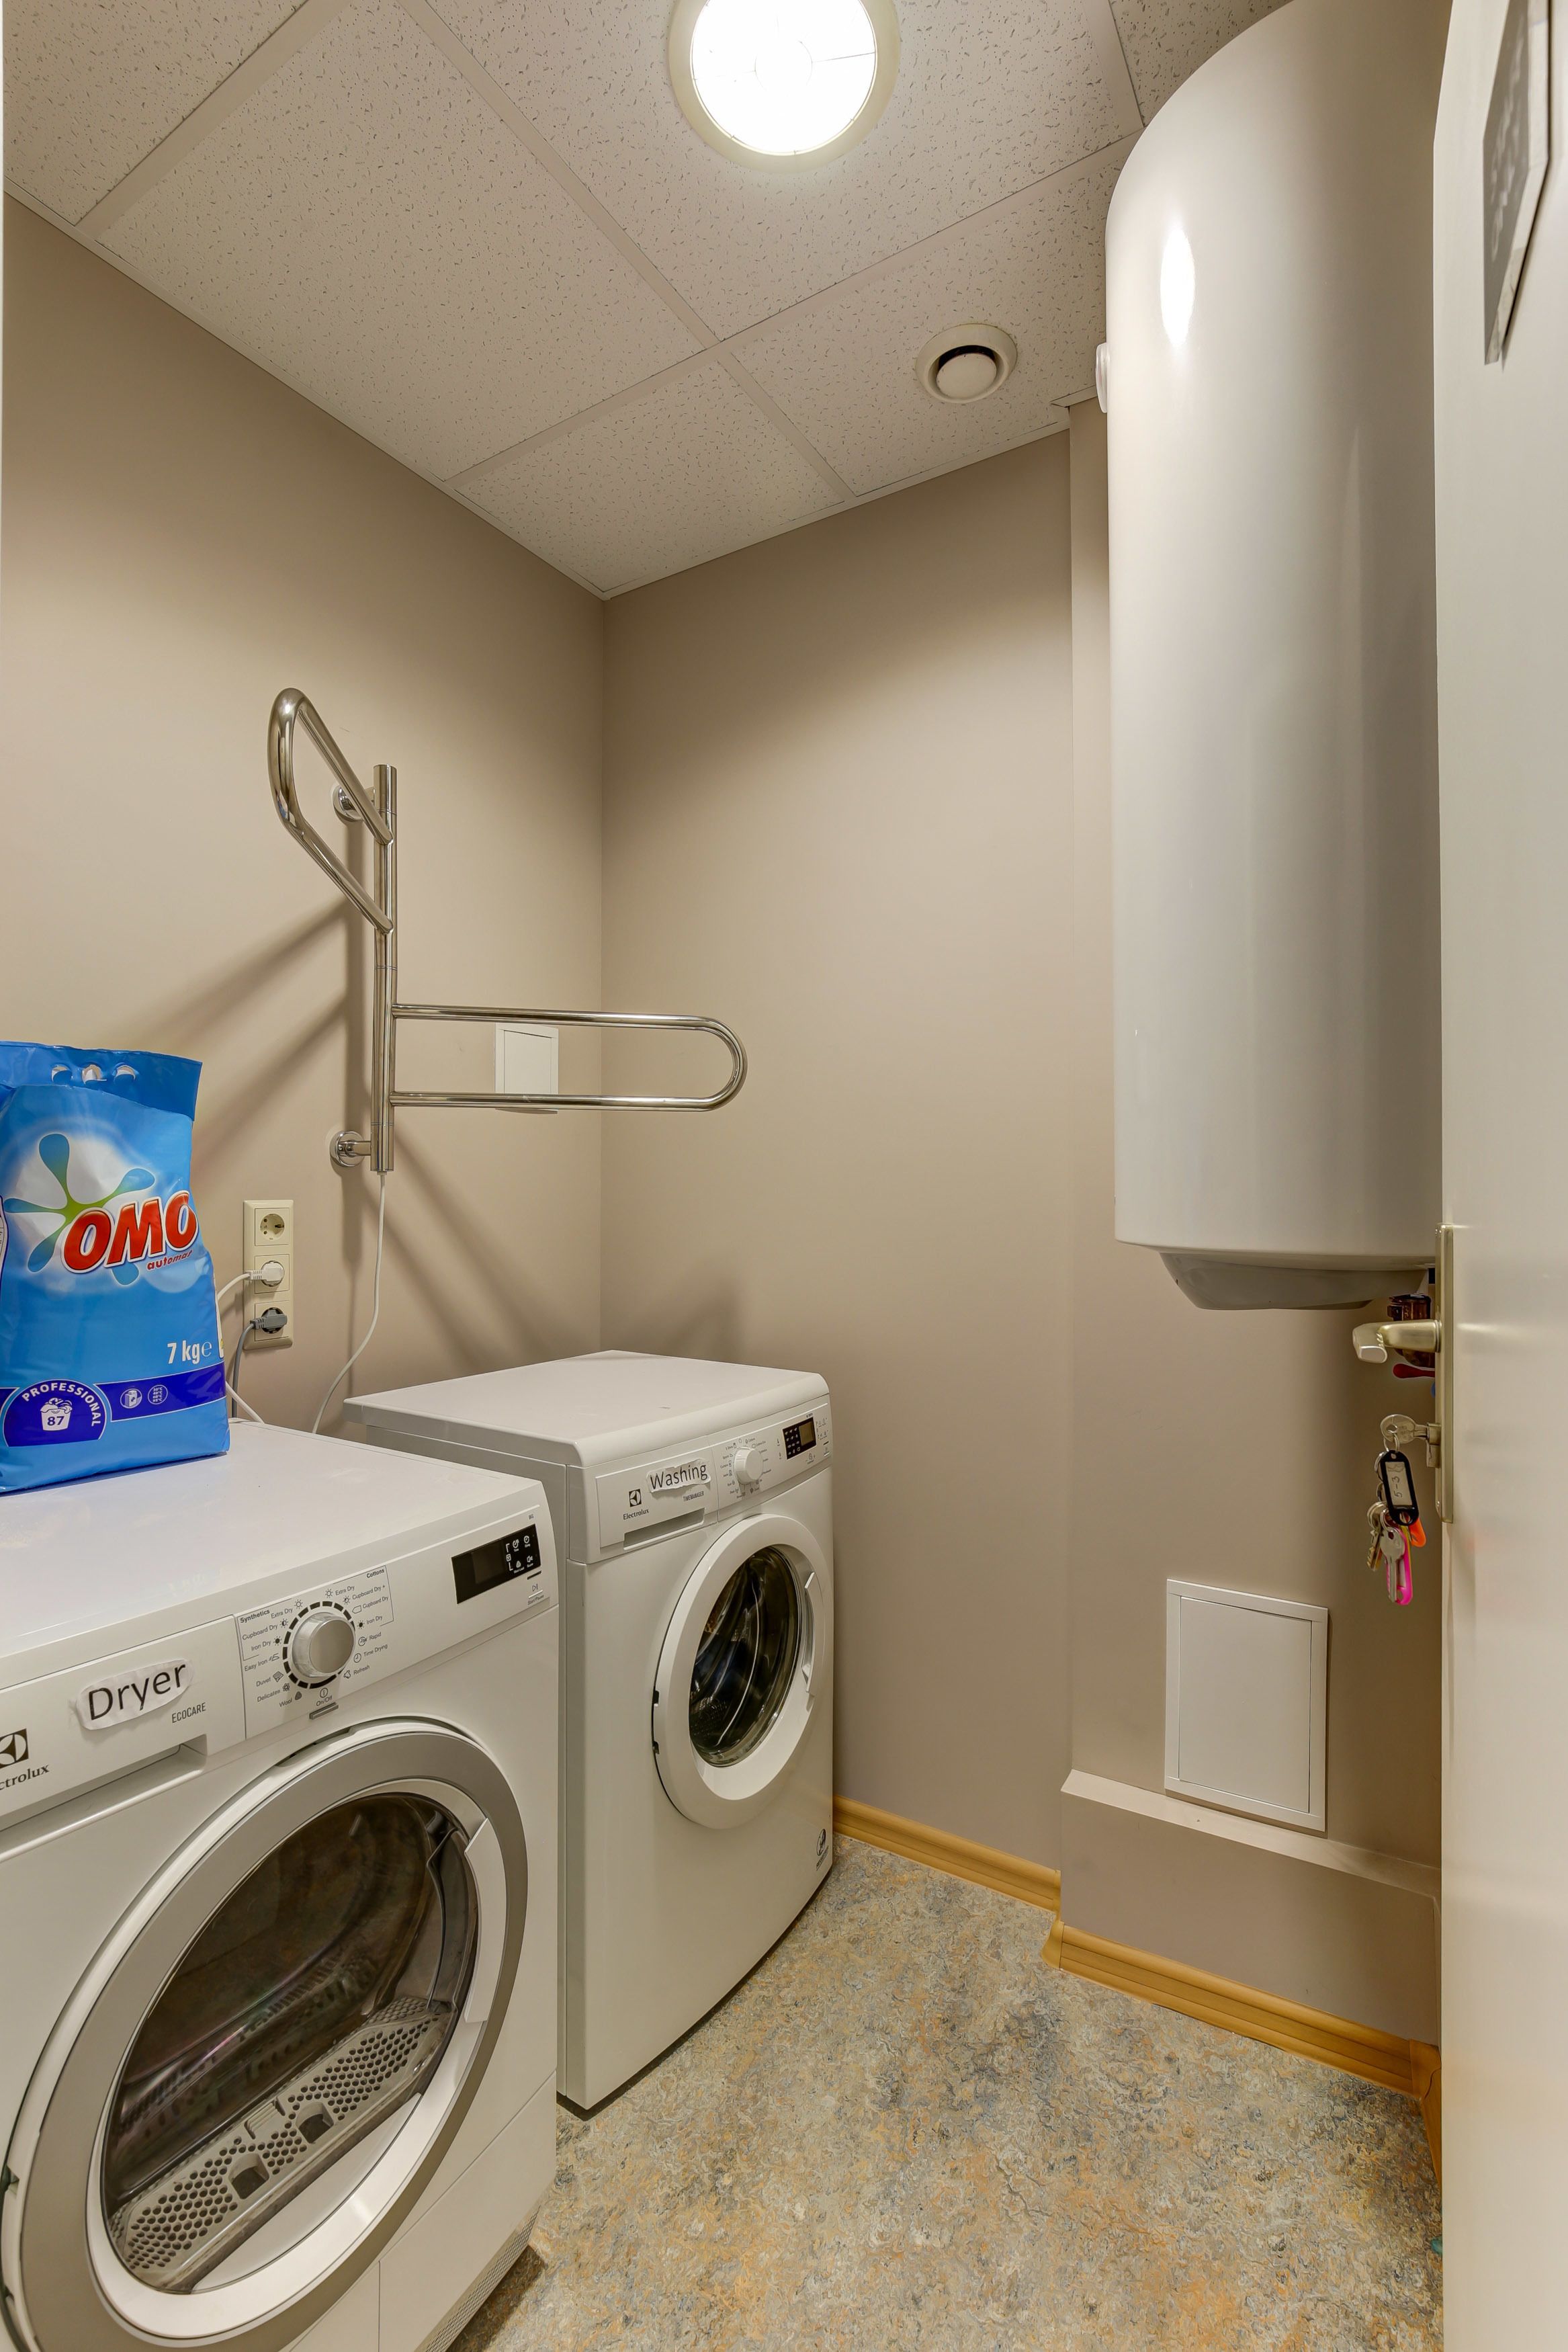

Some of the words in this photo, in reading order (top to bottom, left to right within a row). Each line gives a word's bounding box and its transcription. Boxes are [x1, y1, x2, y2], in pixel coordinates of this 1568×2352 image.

[62, 1191, 198, 1272] OMO
[146, 1250, 193, 1270] automat
[167, 1343, 177, 1364] 7
[21, 1382, 101, 1427] PROFESSIONAL
[47, 1415, 64, 1427] 87
[650, 1464, 708, 1490] Washing
[623, 1509, 649, 1520] Electrolux
[366, 1568, 385, 1579] Cottons
[352, 1589, 374, 1600] Cupboard
[362, 1598, 382, 1609] Cupboard
[240, 1609, 270, 1624] Synthetics
[242, 1627, 268, 1640] Cupboard
[369, 1631, 382, 1640] Rapid
[374, 1644, 388, 1652] Drying
[353, 1665, 370, 1675] Refresh
[256, 1677, 271, 1687] Duvet
[87, 1663, 187, 1721] Dryer
[257, 1689, 281, 1702] Delicates
[279, 1697, 293, 1707] Wool
[316, 1695, 333, 1706] On/Off
[171, 1702, 207, 1723] ECOCARE
